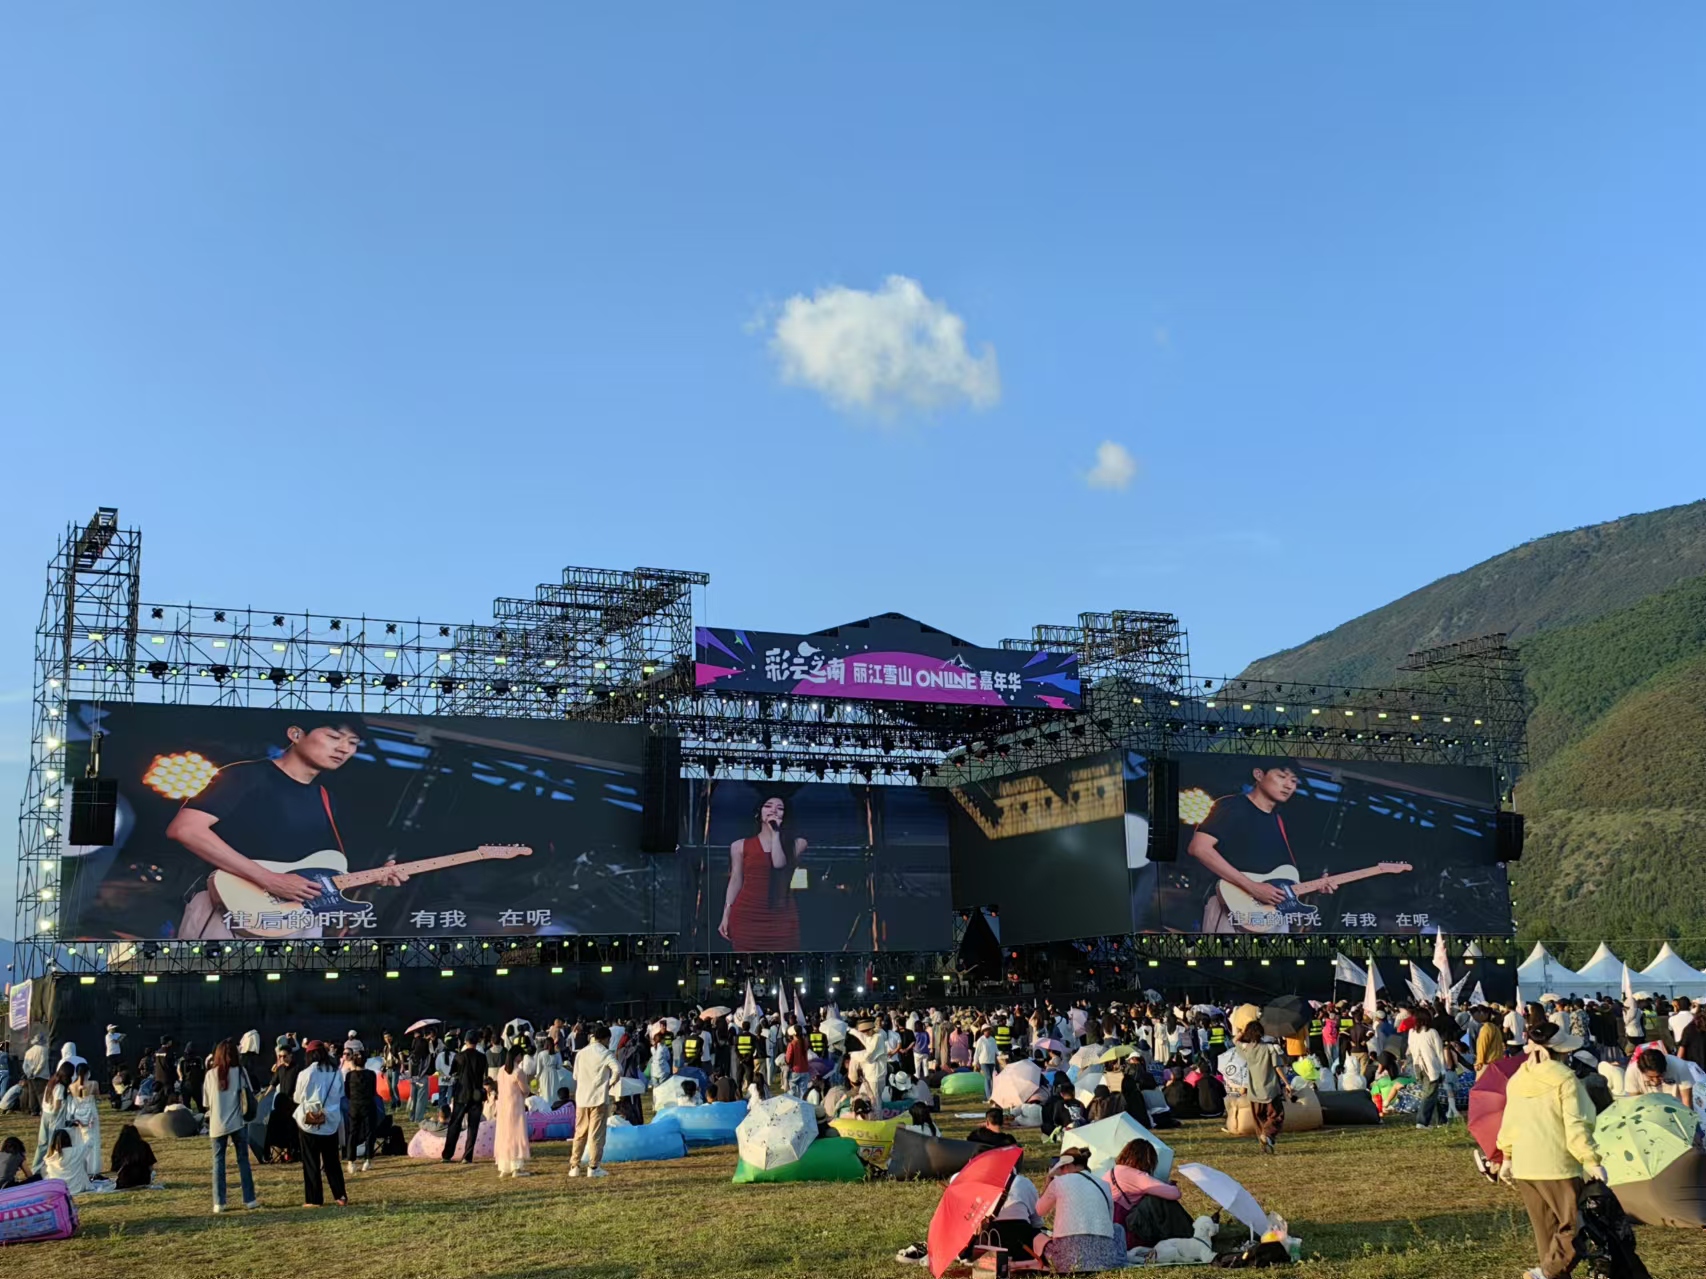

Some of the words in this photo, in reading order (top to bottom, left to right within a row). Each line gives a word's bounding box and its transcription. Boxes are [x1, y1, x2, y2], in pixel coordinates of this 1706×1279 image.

[765, 647, 845, 684] 彩云之南
[853, 662, 912, 686] 丽江雪山
[915, 670, 977, 690] ONLINE
[979, 670, 1022, 693] 嘉年华
[223, 910, 377, 930] 往后的时光
[410, 909, 467, 929] 有我
[498, 908, 552, 927] 在呢
[1228, 911, 1322, 928] 往后的时光
[1341, 911, 1377, 927] 有我
[1396, 912, 1430, 927] 在呢
